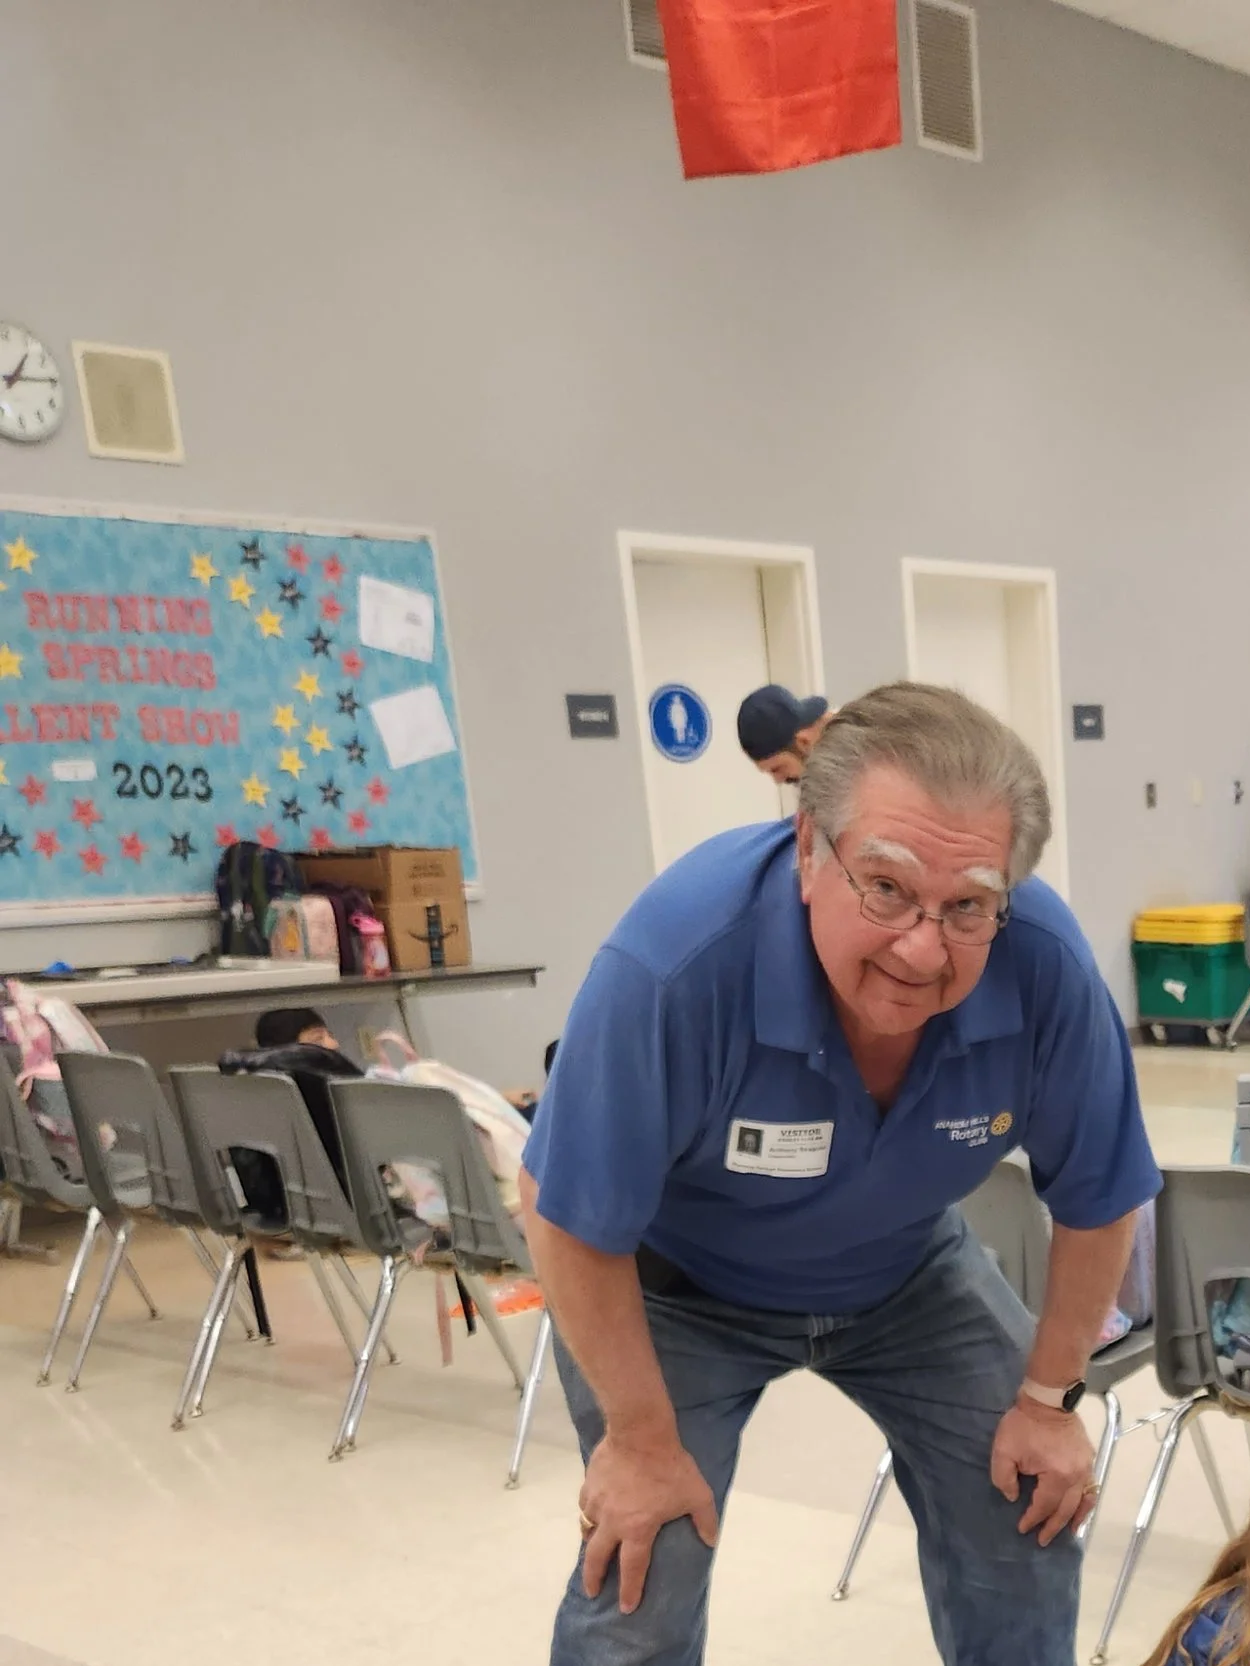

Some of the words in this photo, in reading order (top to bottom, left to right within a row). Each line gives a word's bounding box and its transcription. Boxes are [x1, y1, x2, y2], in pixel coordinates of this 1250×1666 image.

[23, 591, 213, 637] RUNNING
[42, 642, 216, 690] SPRINGS
[0, 703, 120, 743] LENT
[138, 704, 240, 747] SHOW
[112, 760, 213, 803] 2023
[950, 1126, 988, 1141] Rotary
